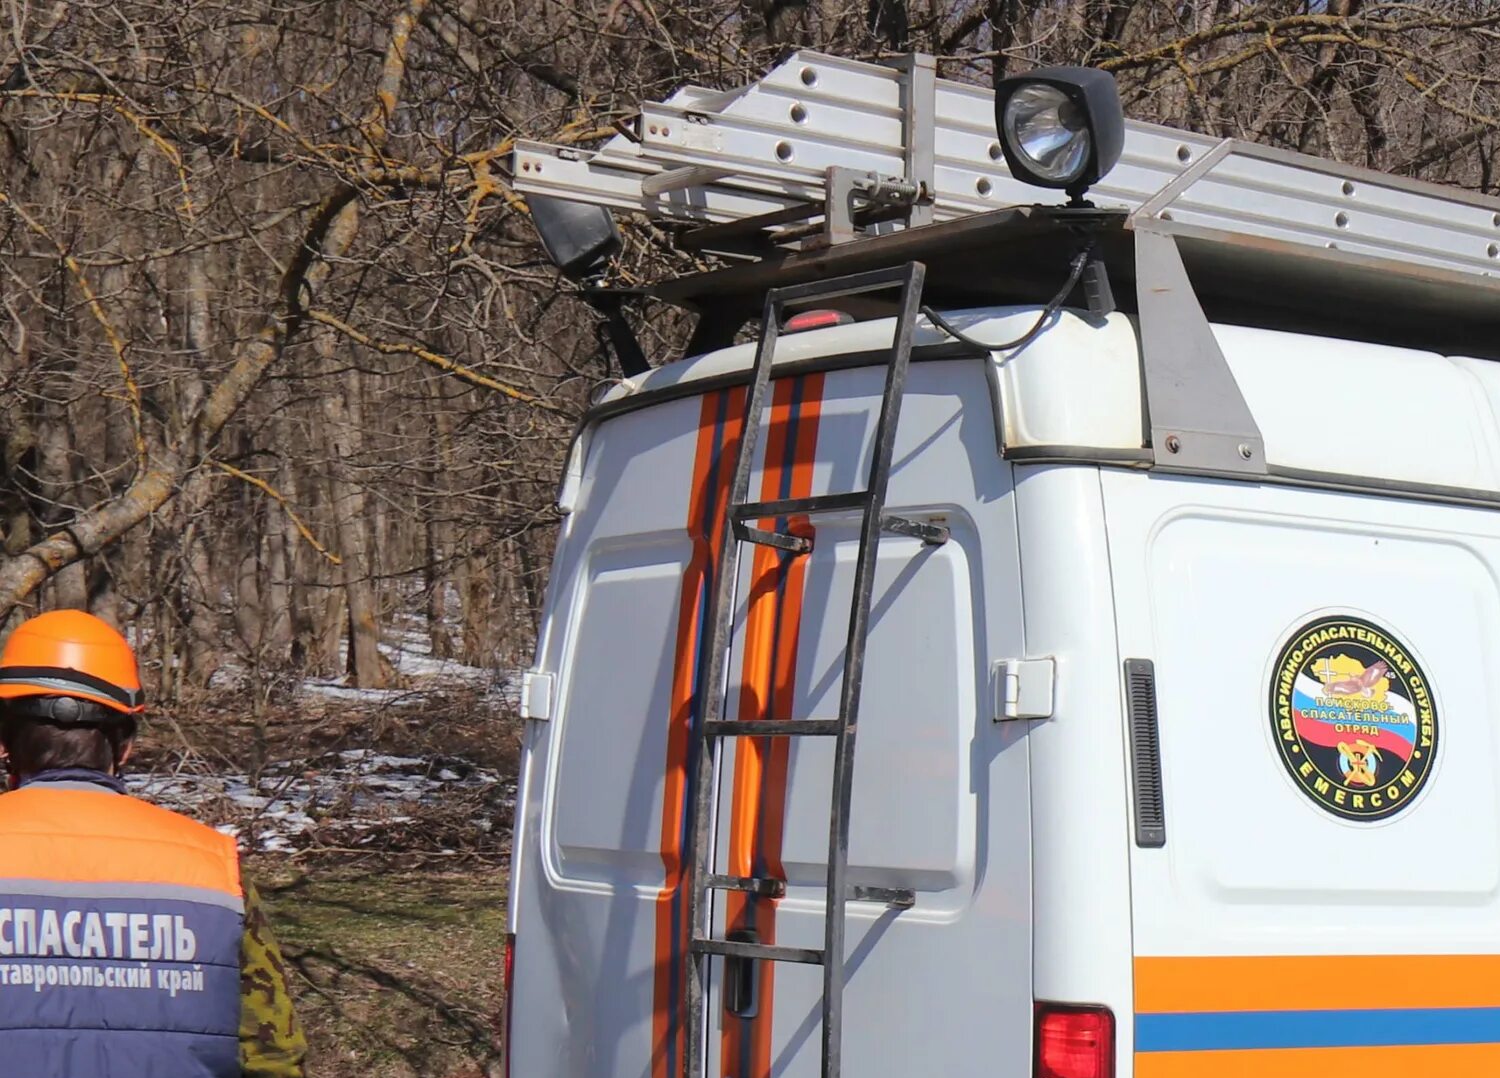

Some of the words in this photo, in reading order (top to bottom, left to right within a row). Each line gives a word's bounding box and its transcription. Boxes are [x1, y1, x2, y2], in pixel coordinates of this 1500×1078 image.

[1279, 626, 1411, 742] АВАРИЙНО-СПАСАТЕЛЬНАЯ
[1410, 675, 1432, 748] СЛУЖБА
[1301, 709, 1410, 725] СПАСАТЕЛЬНЫЙ
[1315, 697, 1394, 713] ПОИСКОВО-
[1335, 724, 1379, 737] ОТРЯД
[1299, 761, 1416, 808] EMERCOM
[0, 908, 196, 961] СПАСАТЕЛЬ
[0, 962, 151, 992] тавропольский
[158, 964, 204, 997] край
